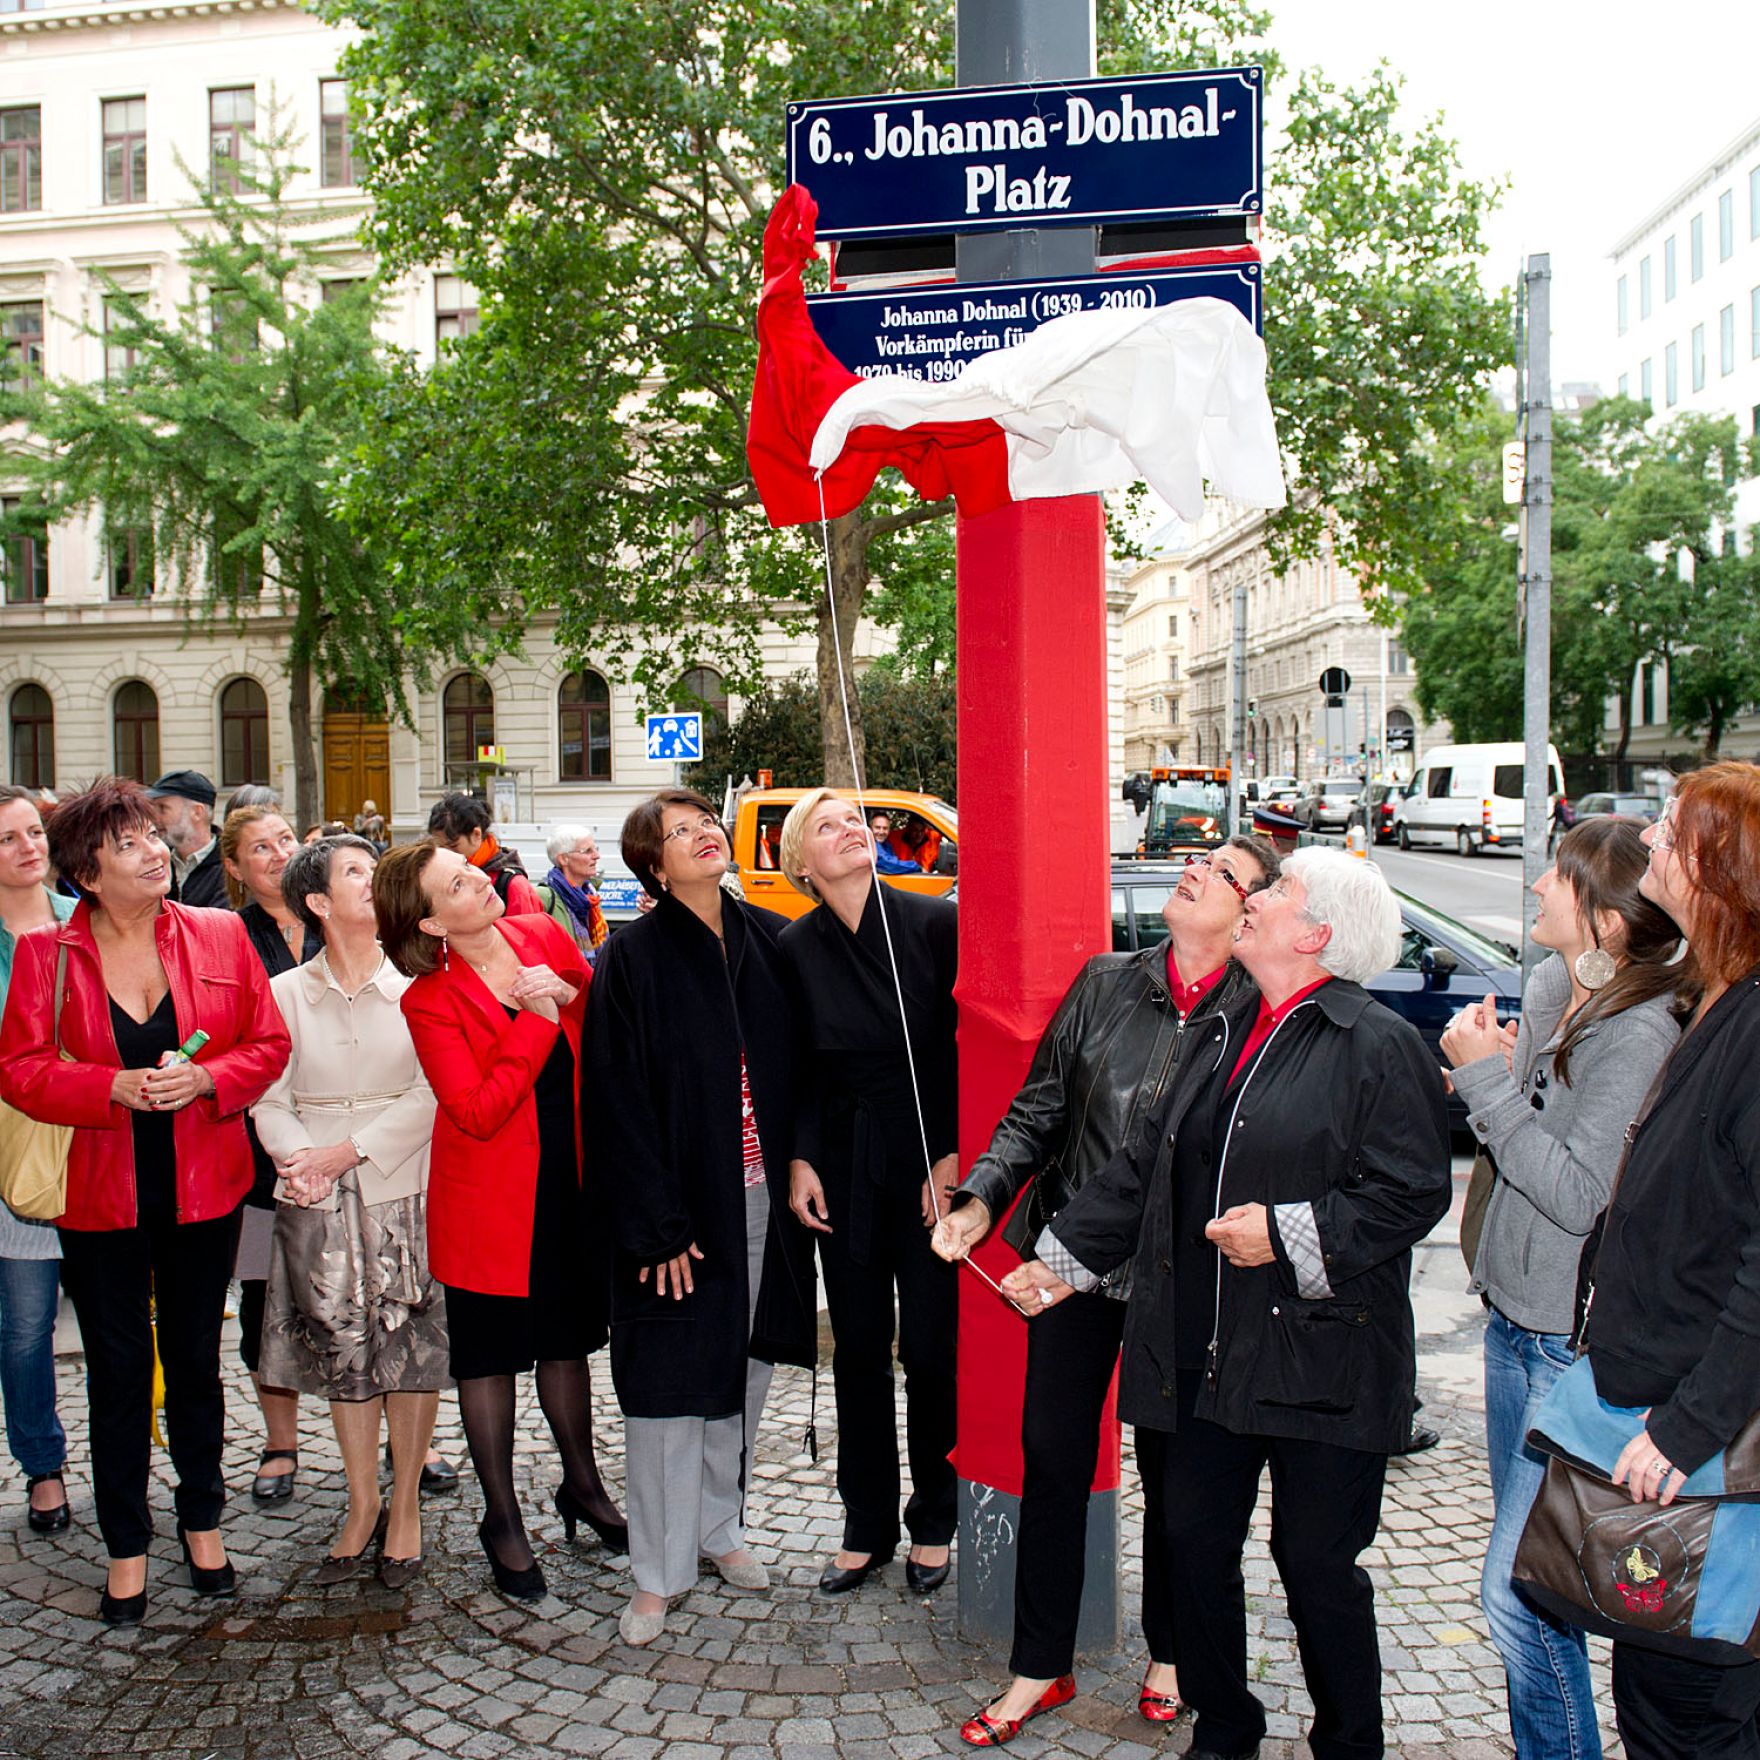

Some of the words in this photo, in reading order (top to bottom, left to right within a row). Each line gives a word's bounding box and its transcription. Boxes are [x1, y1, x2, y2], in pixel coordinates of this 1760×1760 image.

[808, 117, 855, 166] 6.,
[864, 87, 1237, 160] Johanna-Dohnal-
[965, 163, 1072, 214] Platz
[880, 304, 959, 328] Johanna
[962, 296, 1027, 322] Dohnal
[1031, 291, 1083, 322] (1939
[1100, 284, 1157, 309] 2010)
[875, 329, 1001, 359] Vorkämpferin
[1003, 326, 1026, 348] fü
[896, 363, 922, 381] bis
[925, 359, 967, 381] 1990
